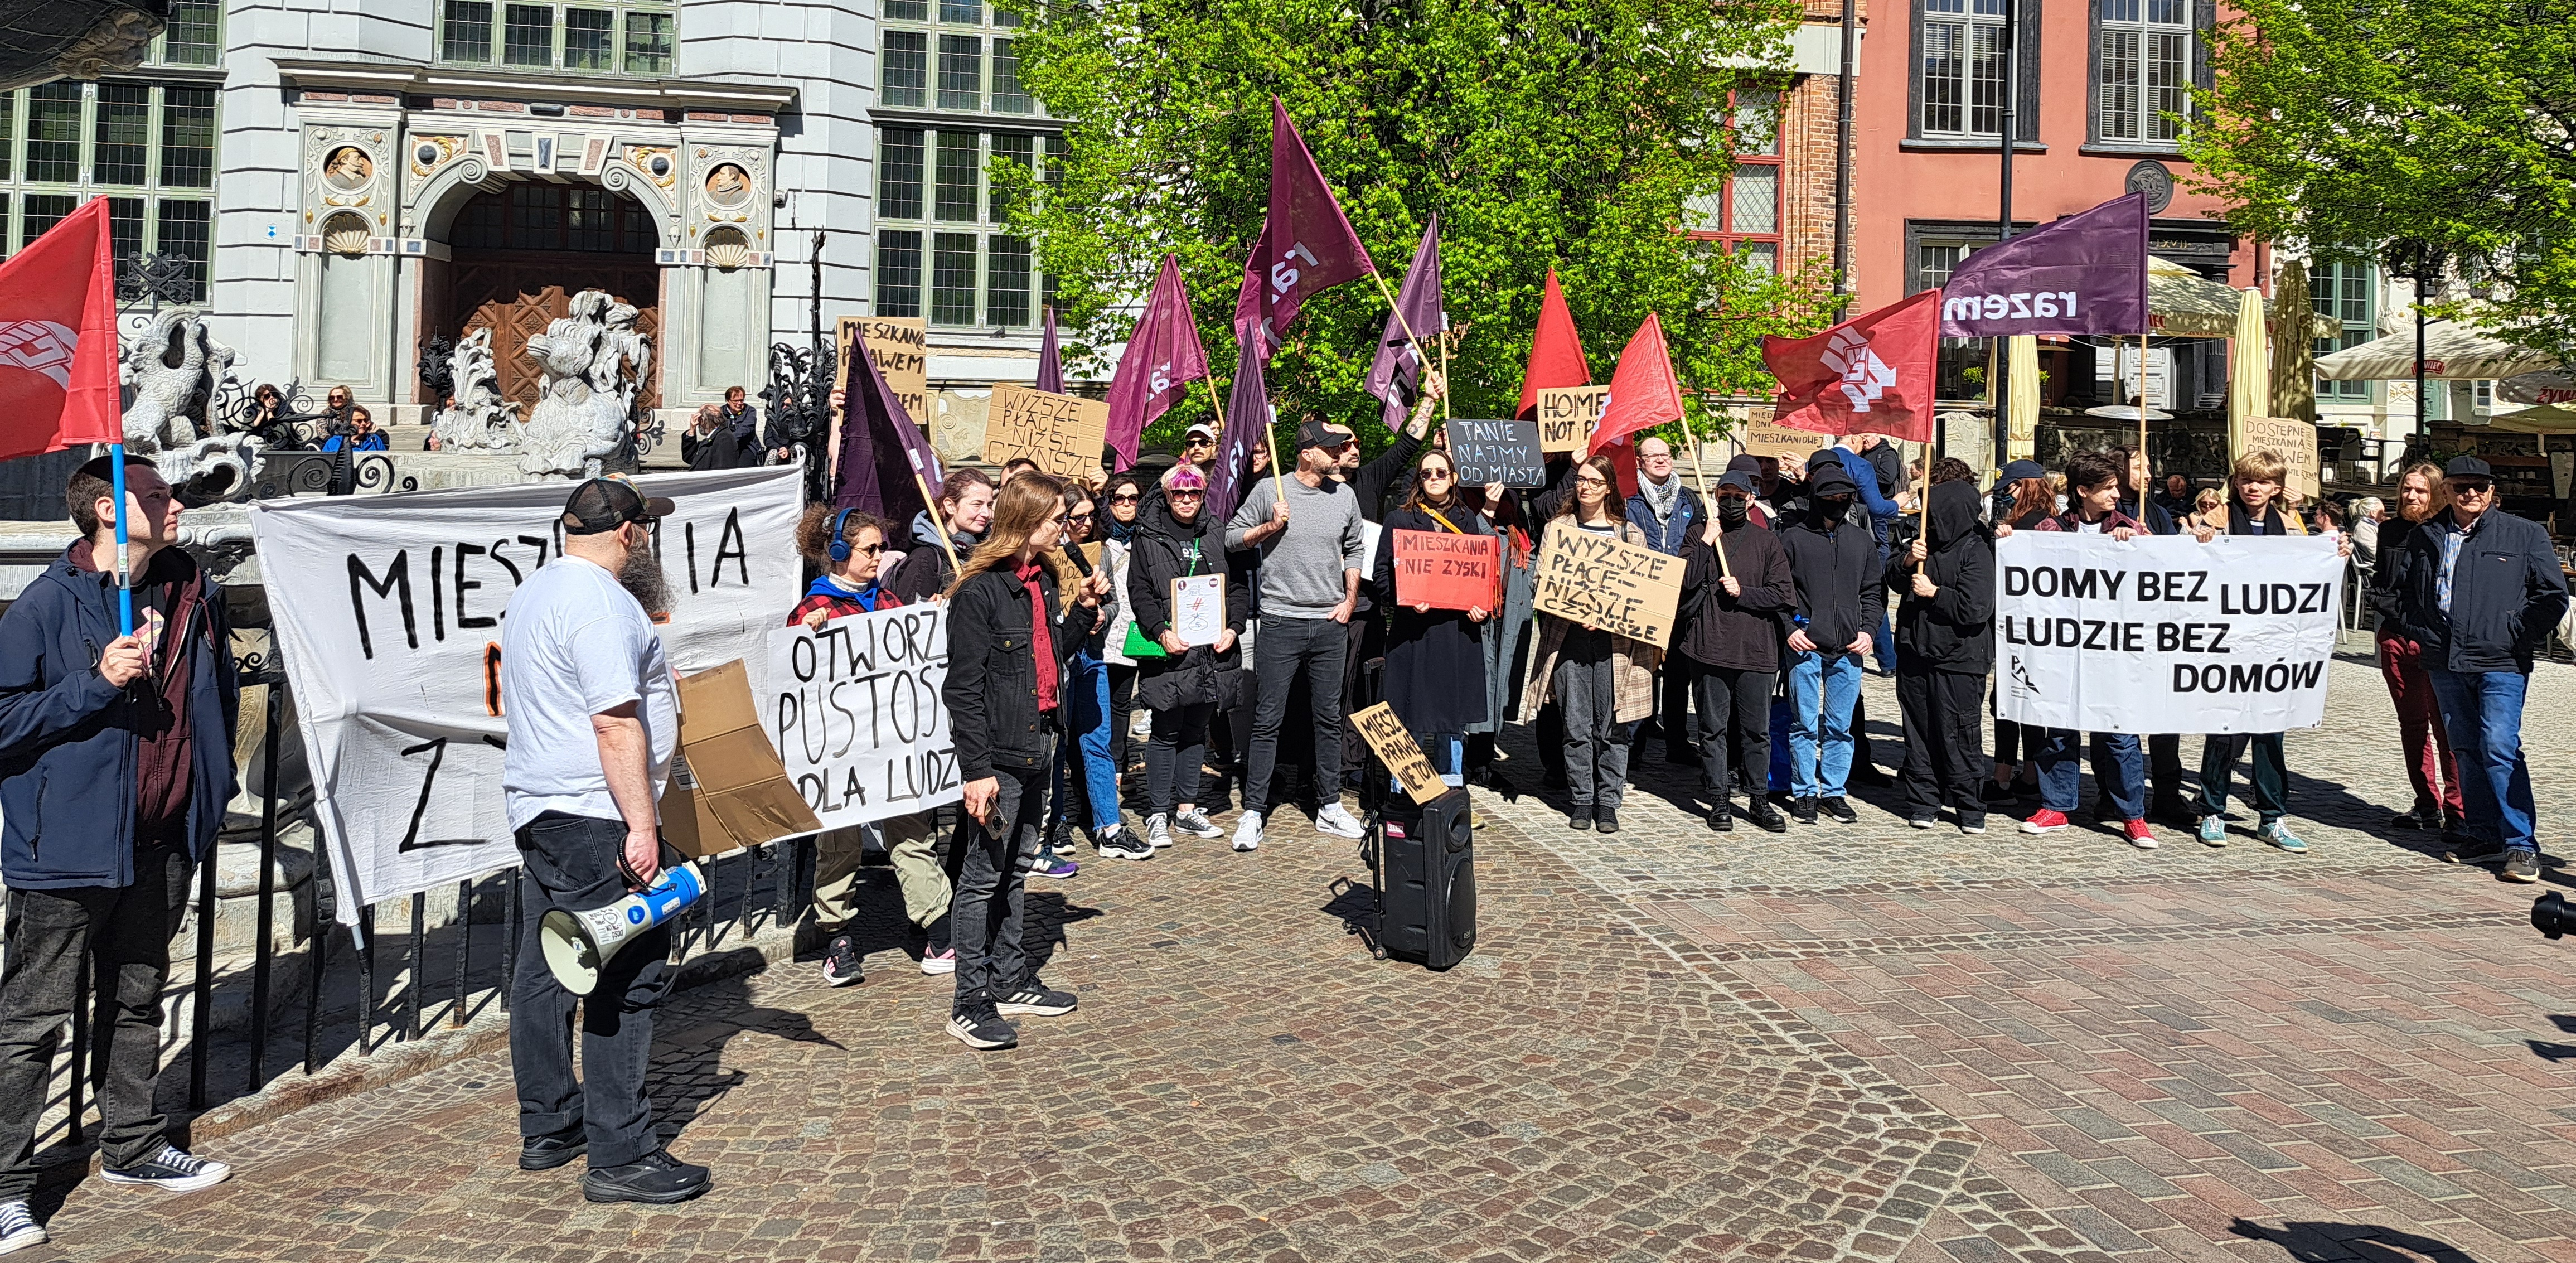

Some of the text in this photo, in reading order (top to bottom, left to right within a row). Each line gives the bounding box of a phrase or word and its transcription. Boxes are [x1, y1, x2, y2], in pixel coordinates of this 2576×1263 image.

[842, 345, 924, 374] PAWEM
[1004, 390, 1082, 422] WYŻSZE
[1003, 409, 1066, 434] PŁACE
[1544, 420, 1576, 443] NOT
[1751, 432, 1824, 448] MIESZKANIOWEJ
[2252, 435, 2306, 449] MIESZKANIA
[1457, 444, 1528, 464] NAJMY
[1460, 465, 1483, 482] OD
[1403, 534, 1489, 555] MIESZKANIA
[1405, 559, 1486, 579] NIE ZYSKI
[2004, 566, 2331, 615] DOMY BEZ LUDZI
[2006, 615, 2230, 653] LUDZIE BEZ
[2173, 657, 2325, 693] DOMÓW
[797, 765, 866, 813] DLA
